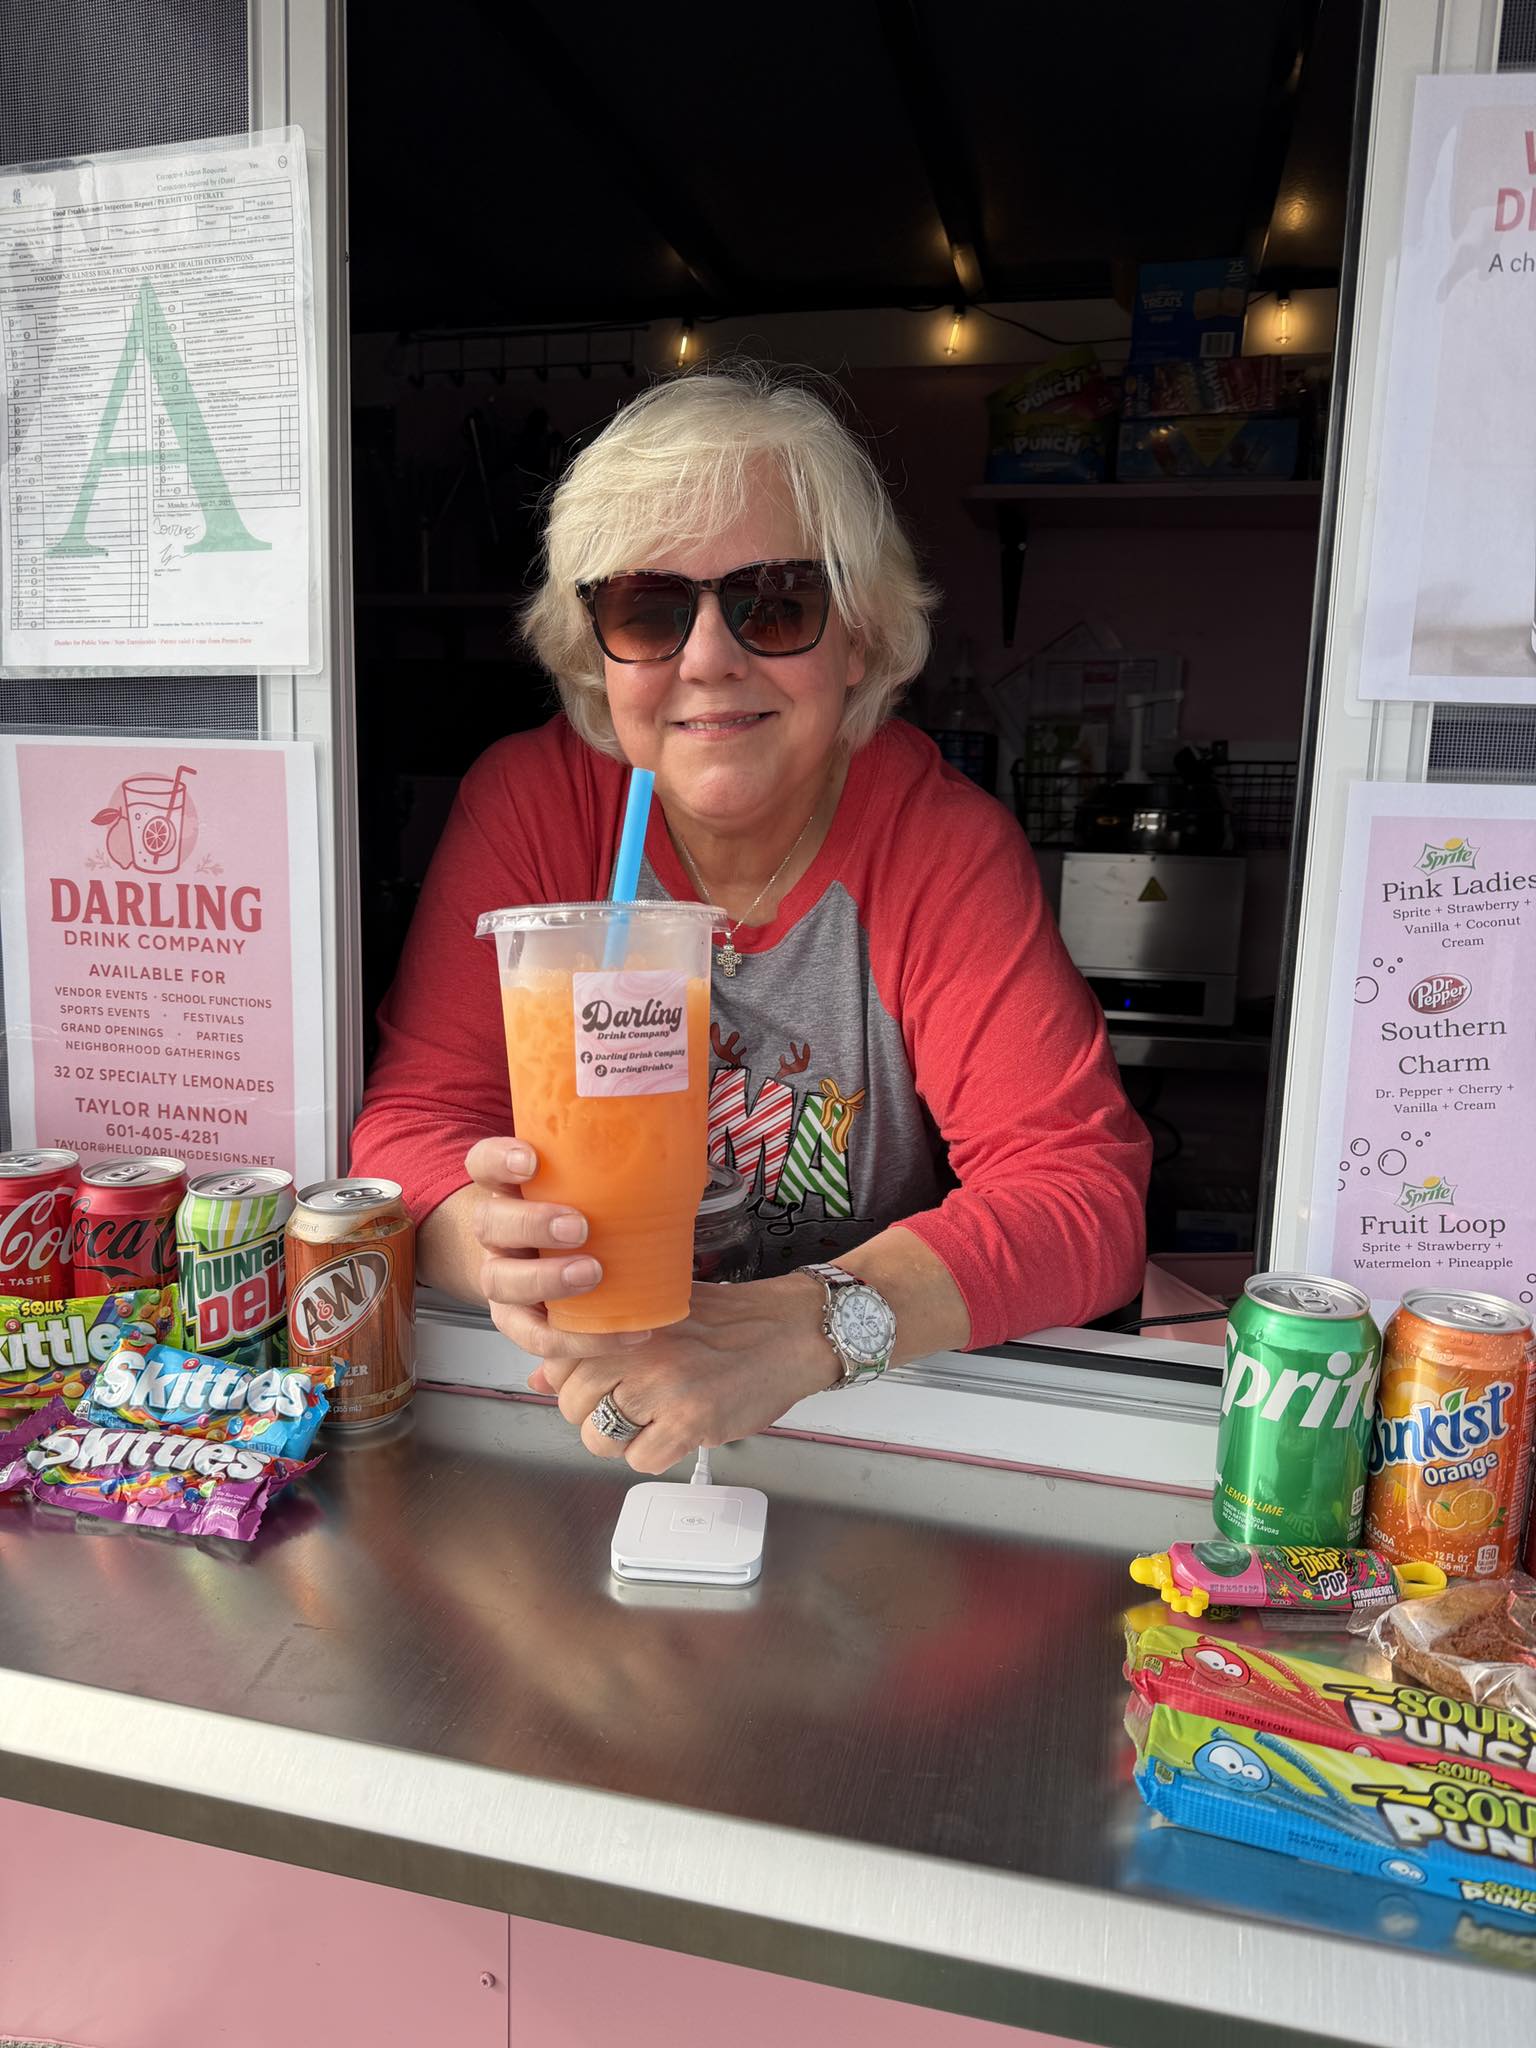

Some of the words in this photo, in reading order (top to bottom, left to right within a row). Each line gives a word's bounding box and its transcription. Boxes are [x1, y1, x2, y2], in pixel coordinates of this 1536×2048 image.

[134, 200, 154, 209] Report
[184, 194, 193, 202] TO
[193, 192, 225, 200] OPERATE
[112, 266, 140, 276] FACTORS
[155, 262, 178, 270] PUBLIC
[179, 259, 203, 268] HEALTH
[204, 255, 254, 266] INTERVENTIONS
[44, 276, 272, 557] A
[1421, 848, 1473, 870] Sprite
[1382, 879, 1443, 903] Pink
[1452, 871, 1536, 896] Ladies
[50, 878, 262, 932] DARLING
[1392, 907, 1431, 921] Sprite
[1447, 900, 1519, 915] Strawberry
[1404, 920, 1449, 935] Vanilla
[1466, 916, 1521, 930] Coconut
[64, 930, 130, 949] DRINK
[138, 933, 245, 954] COMPANY
[1441, 937, 1484, 949] Cream
[89, 964, 183, 982] AVAILABLE
[191, 970, 226, 984] FOR
[1432, 975, 1453, 990] Dr
[55, 986, 102, 998] VENDOR
[106, 989, 148, 1001] EVENTS
[161, 993, 206, 1005] SCHOOL
[209, 996, 272, 1009] FUNCTIONS
[1417, 981, 1467, 1009] Pepper
[60, 1005, 104, 1016] SPORTS
[107, 1007, 150, 1019] EVENTS
[183, 1012, 244, 1025] FESTIVALS
[582, 998, 683, 1033] Darling
[61, 1023, 101, 1034] GRAND
[105, 1025, 163, 1038] OPENINGS
[196, 1031, 244, 1043] PARTIES
[597, 1031, 626, 1040] Drink
[628, 1030, 670, 1039] Company
[1381, 1018, 1507, 1042] Southern
[65, 1041, 161, 1055] NEIGHBORHOOD
[165, 1047, 240, 1061] GATHERINGS
[595, 1052, 628, 1061] Darling
[629, 1050, 653, 1059] Drink
[654, 1049, 685, 1058] Company
[610, 1063, 673, 1073] DarlingDrinkCo
[1398, 1055, 1490, 1075] Charm
[54, 1066, 71, 1078] 32
[76, 1068, 95, 1080] OZ
[99, 1069, 177, 1086] SPECIALTY
[183, 1074, 274, 1093] LEMONADES
[1375, 1088, 1395, 1099] Dr.
[1399, 1086, 1443, 1099] Pepper
[1458, 1083, 1502, 1095] Cherry
[75, 1097, 150, 1118] TAYLOR
[158, 1104, 248, 1125] HANNON
[1393, 1102, 1438, 1114] Vanilla
[1453, 1100, 1496, 1112] Cream
[106, 1123, 219, 1145] 601-405-4281
[54, 1139, 275, 1166] TAYLOR@HELLODARLINGDESIGNS.NET
[1401, 1184, 1450, 1206] Sprite
[1360, 1214, 1429, 1235] Fruit
[1438, 1214, 1506, 1239] Loop
[1362, 1242, 1401, 1254] Sprite
[1417, 1241, 1491, 1253] Strawberry
[1354, 1258, 1431, 1269] Watermelon
[1448, 1257, 1513, 1270] Pineapple
[9, 1275, 52, 1287] TASTE
[20, 1300, 67, 1317] SOUR
[301, 1258, 368, 1346] A&W
[94, 1350, 313, 1417] Skittles
[27, 1427, 272, 1482] Skittles
[1424, 1454, 1498, 1486] Orange
[1225, 1484, 1284, 1517] LEMON-LIME
[1300, 1552, 1341, 1577] DROP
[1446, 1553, 1456, 1561] FL
[1320, 1571, 1347, 1600] POP
[1352, 1585, 1394, 1599] STRAWBERRY
[1225, 1709, 1251, 1722] BEST
[1254, 1718, 1295, 1735] BEFORE
[1396, 1688, 1529, 1747] SOUR
[1351, 1699, 1536, 1773] PUNC
[1436, 1760, 1492, 1785] SOUR
[1433, 1785, 1536, 1838] SOU
[1383, 1802, 1534, 1864] PUN
[1461, 1882, 1536, 1914] PUNC
[1481, 1880, 1536, 1901] SOU
